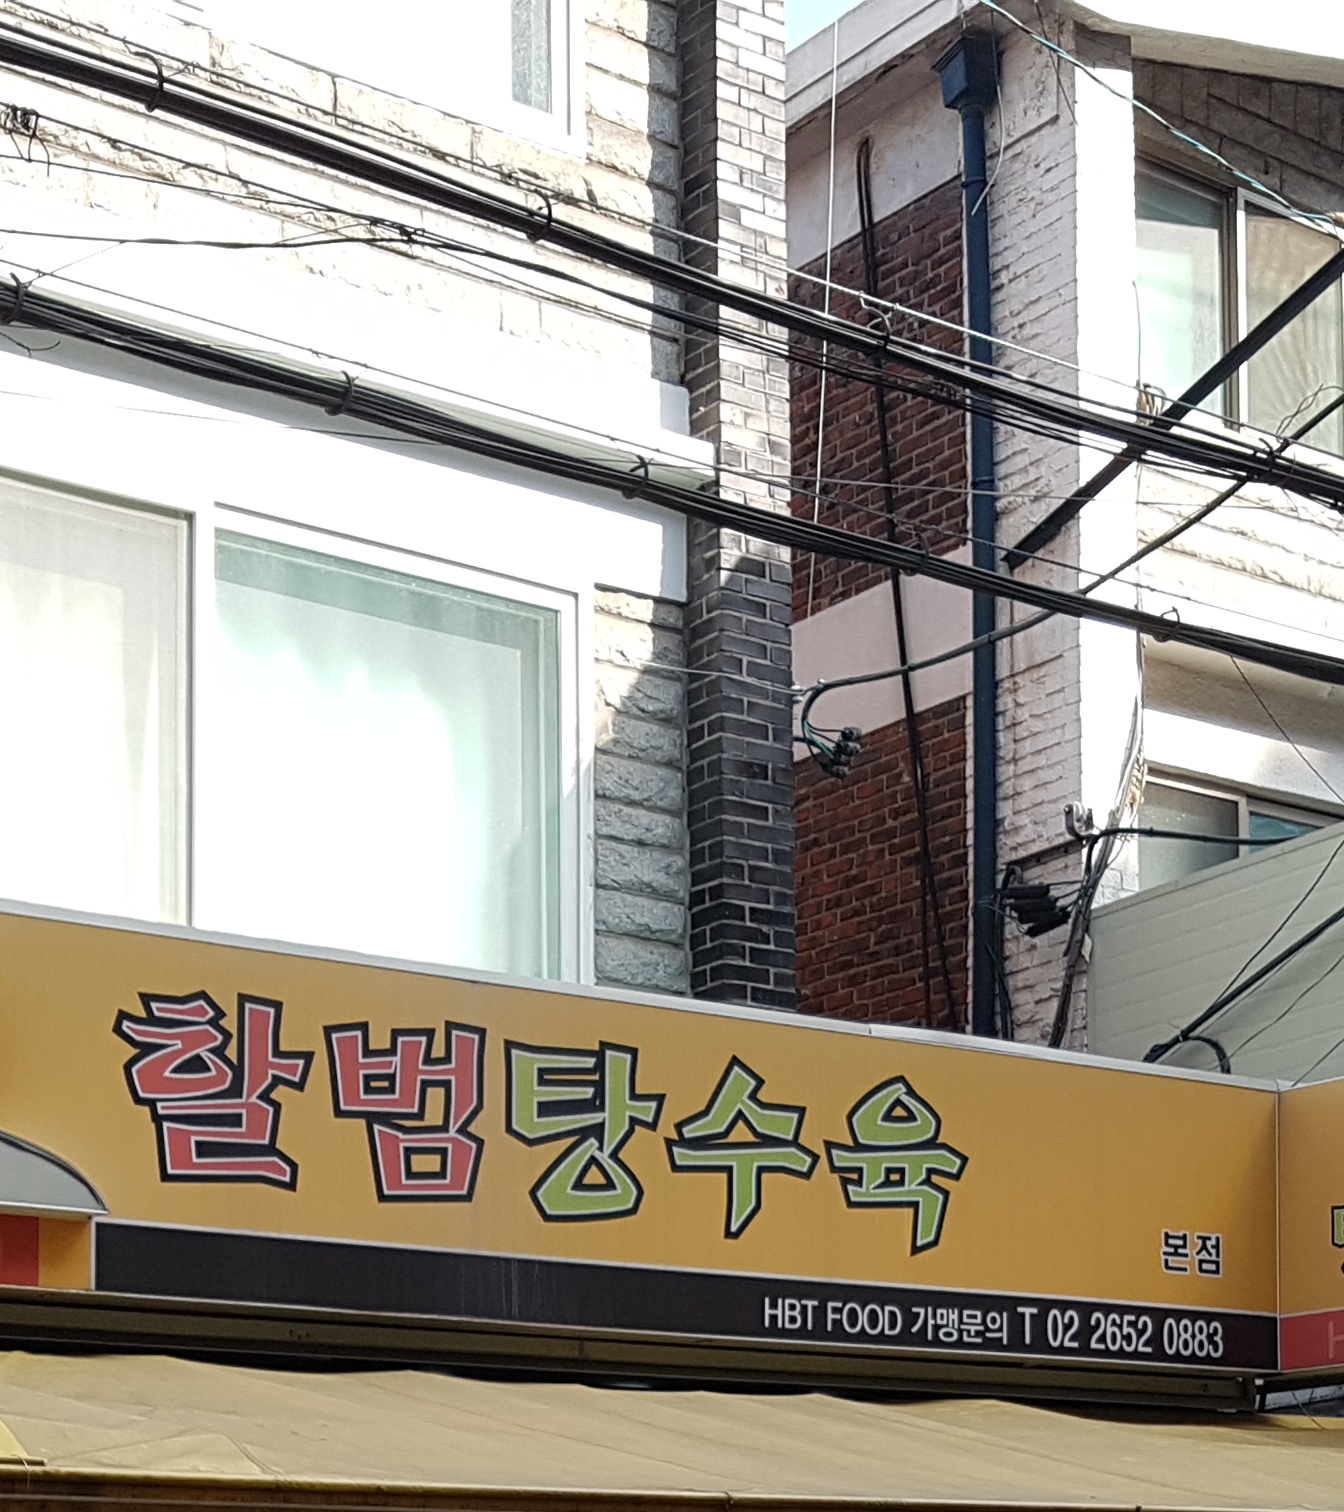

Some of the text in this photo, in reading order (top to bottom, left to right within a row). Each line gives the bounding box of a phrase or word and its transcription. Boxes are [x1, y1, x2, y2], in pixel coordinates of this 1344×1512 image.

[114, 990, 969, 1255] 할범탕수육
[1161, 1228, 1223, 1277] 본점
[763, 1298, 1224, 1358] HBT FOOD 가맹문의 T 02 2652 0883
